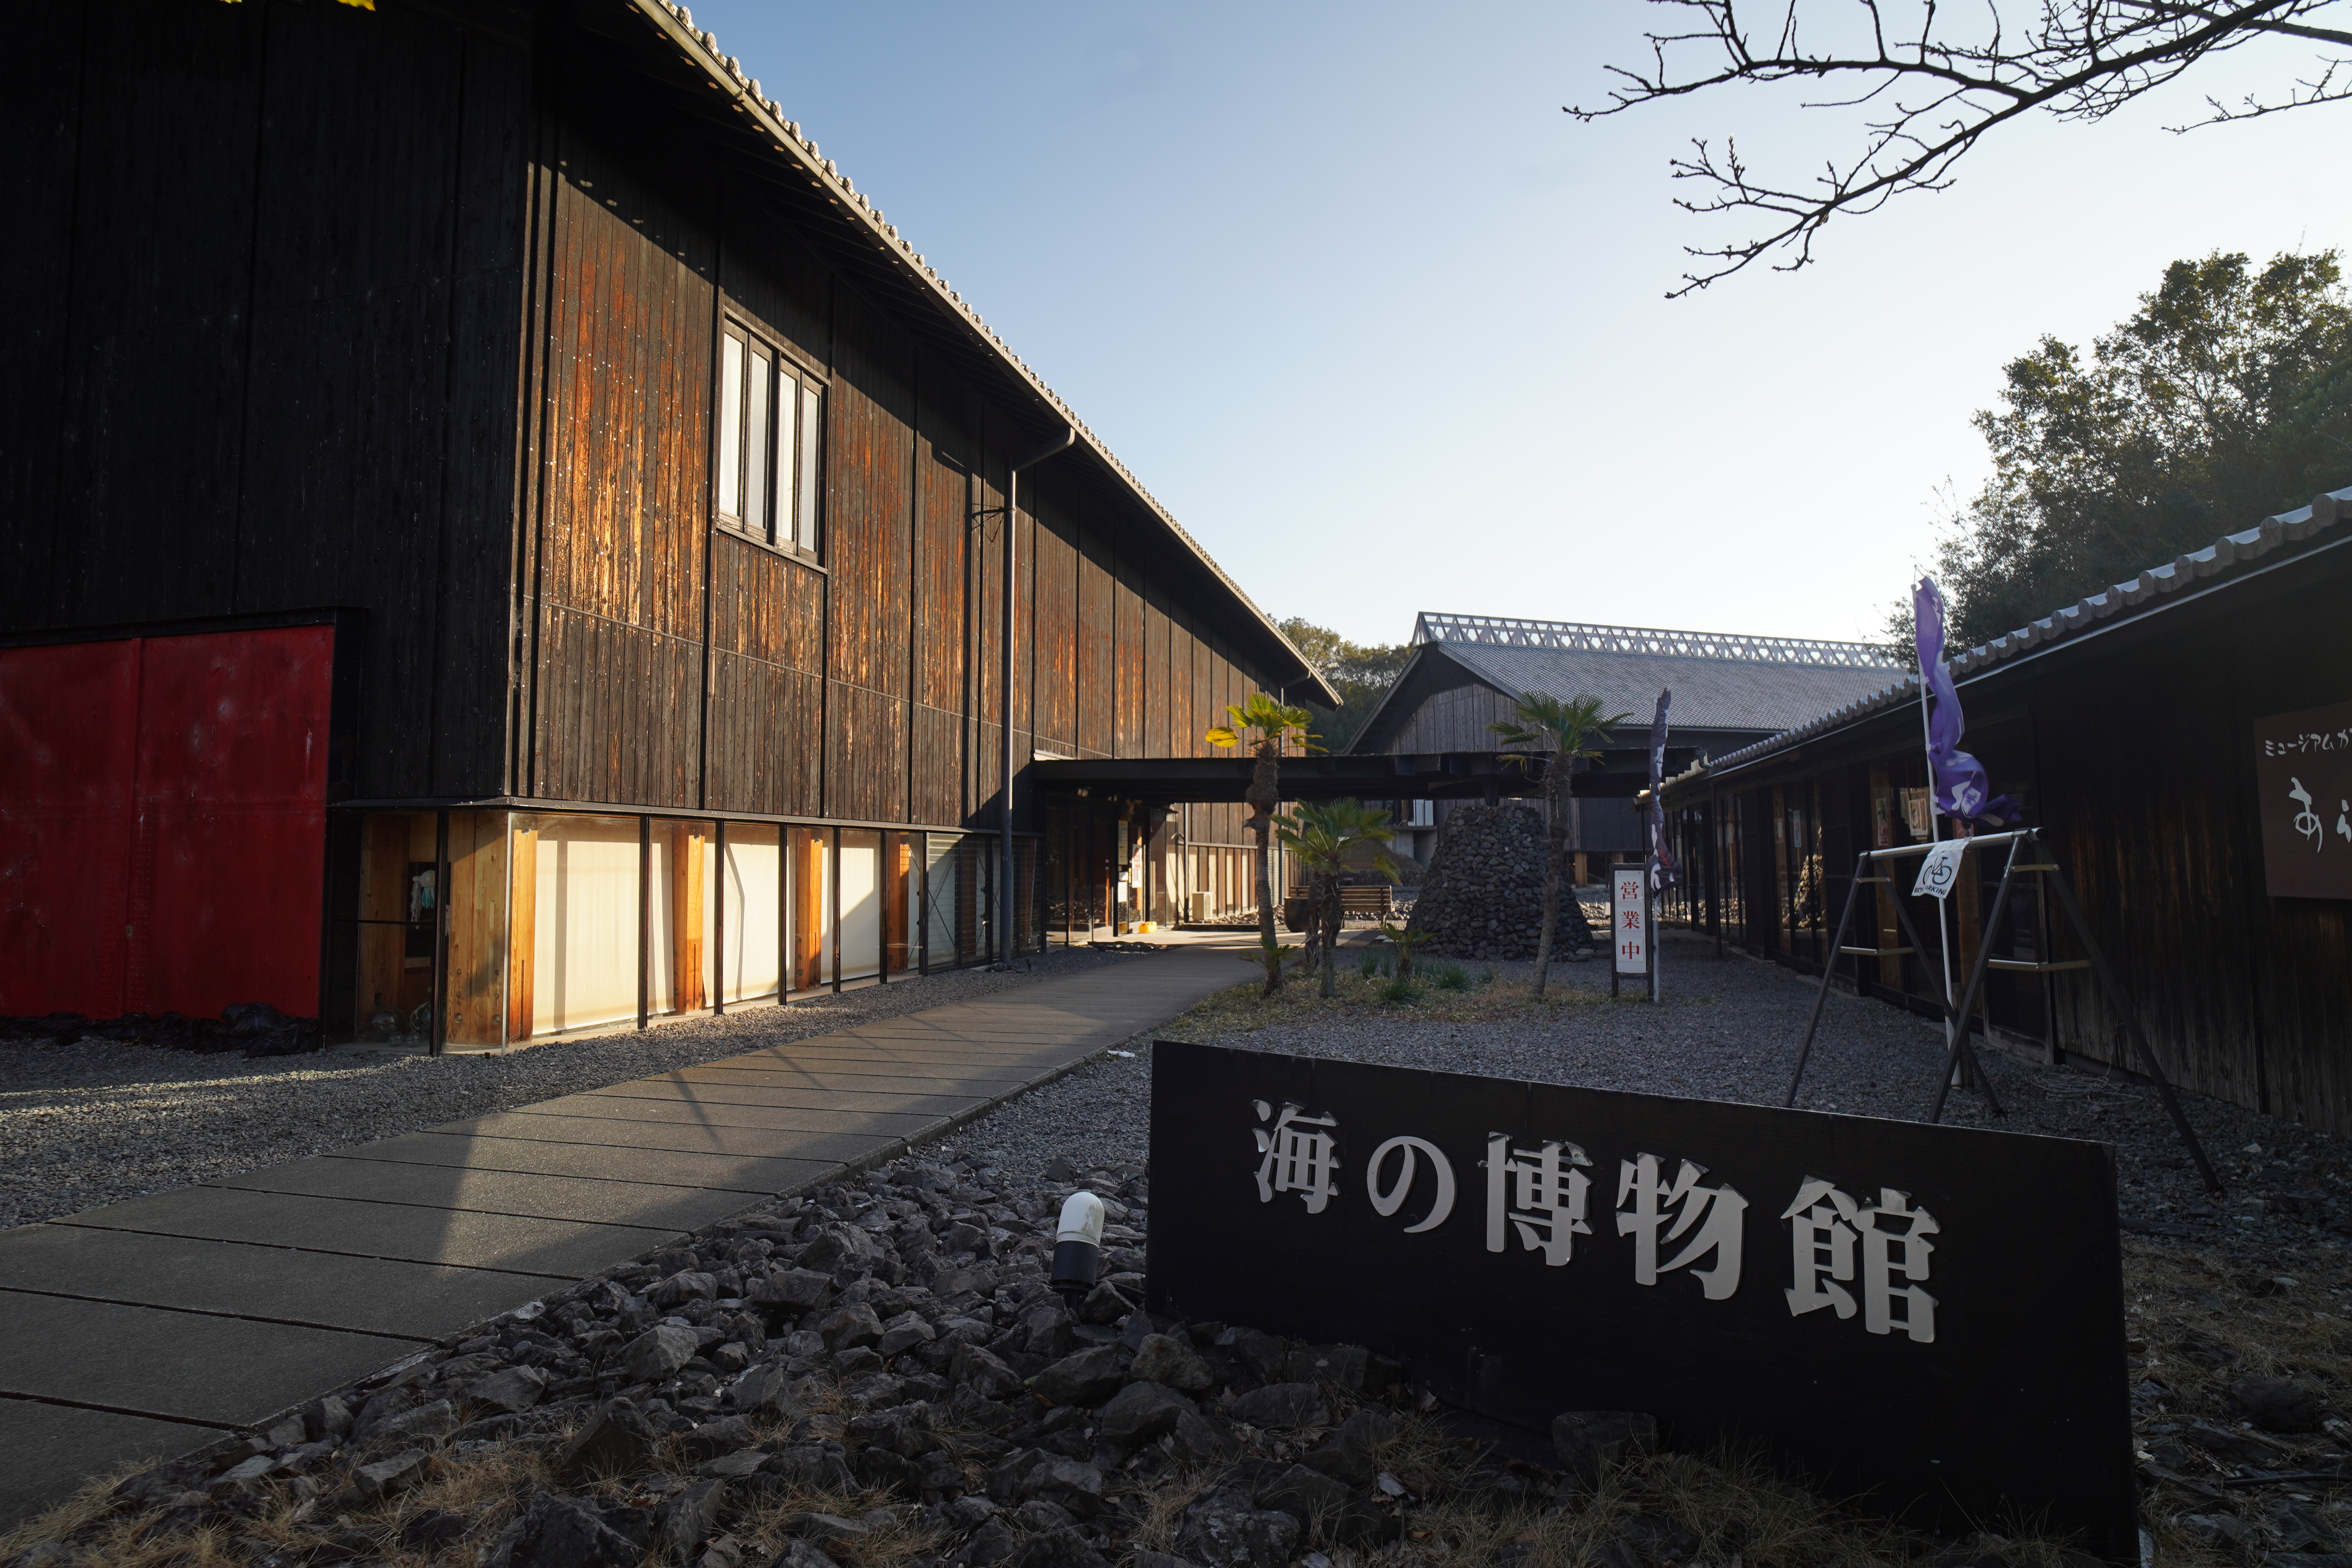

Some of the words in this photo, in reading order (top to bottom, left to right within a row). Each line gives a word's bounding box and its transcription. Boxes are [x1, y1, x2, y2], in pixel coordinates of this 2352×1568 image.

[2265, 728, 2352, 757] ミュージアムカ
[1620, 881, 1640, 959] 営業中
[1251, 1097, 1945, 1344] 海の博物館
